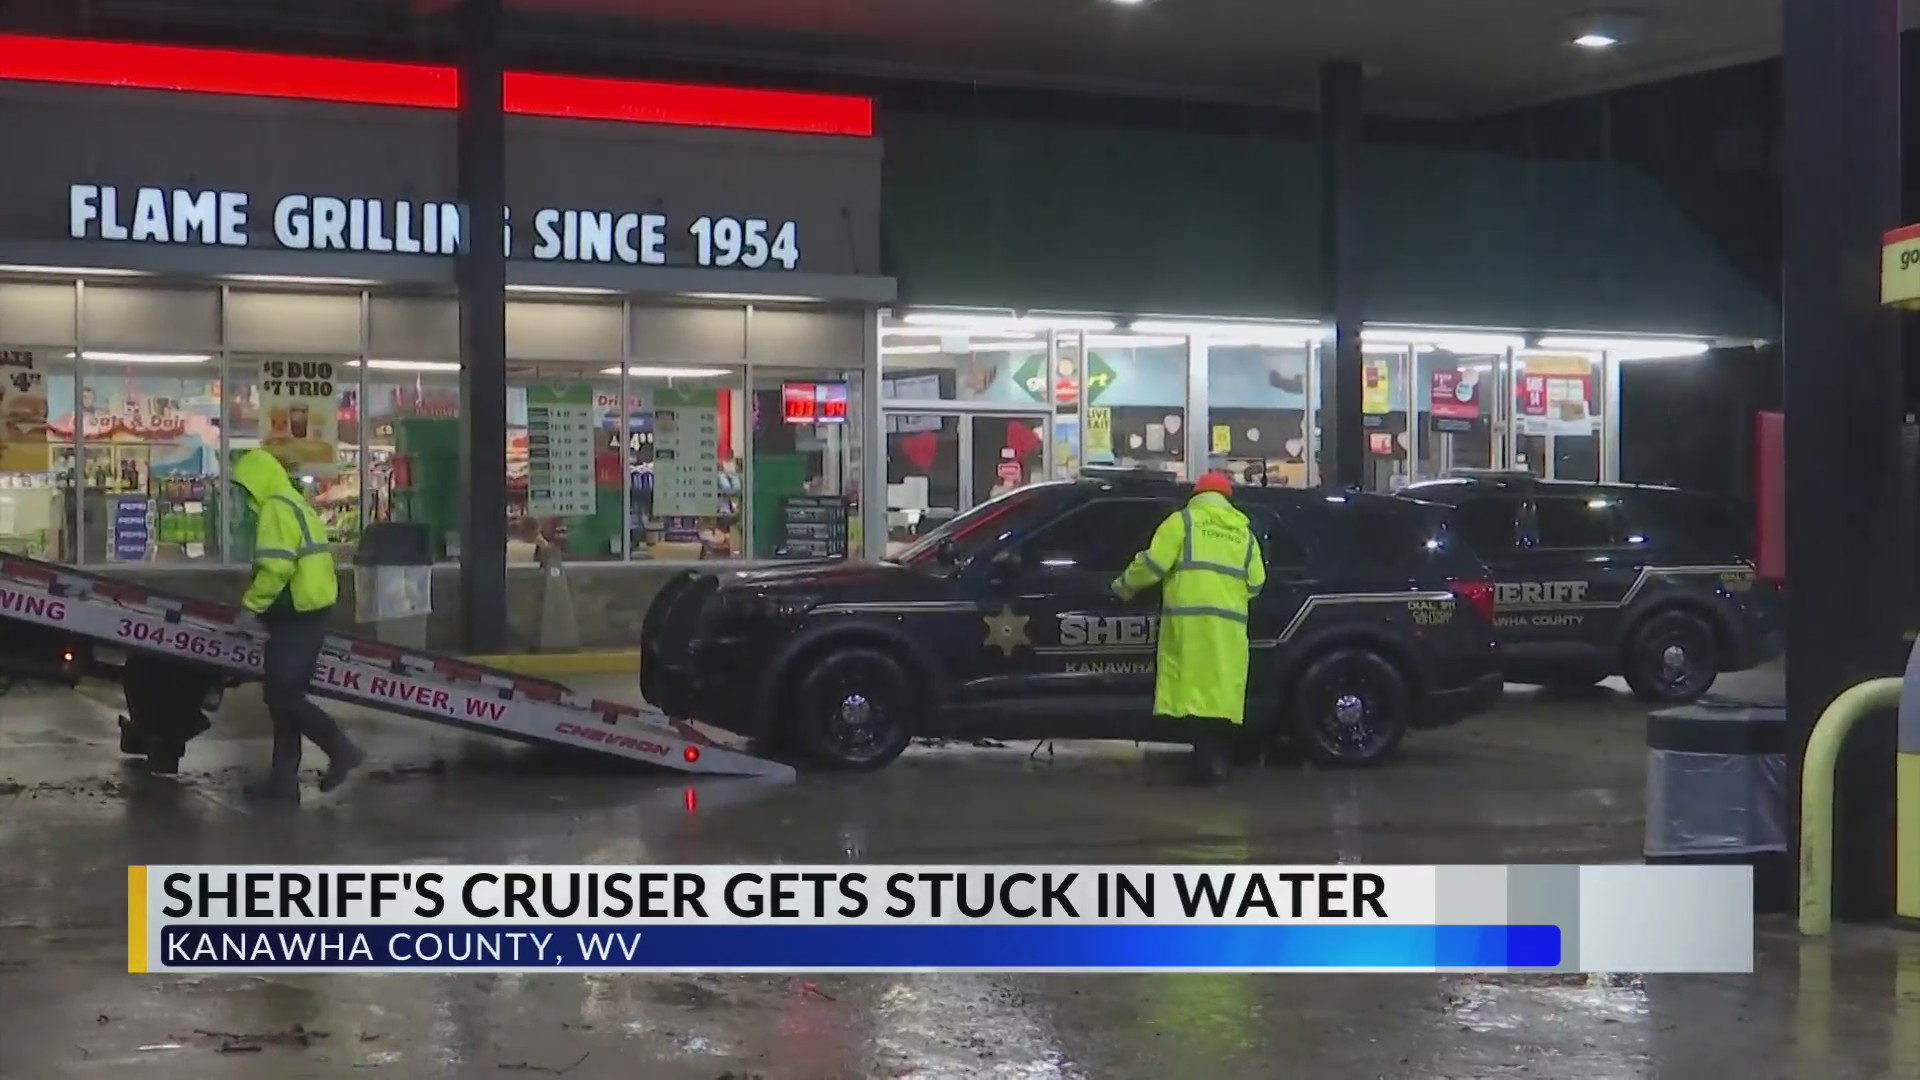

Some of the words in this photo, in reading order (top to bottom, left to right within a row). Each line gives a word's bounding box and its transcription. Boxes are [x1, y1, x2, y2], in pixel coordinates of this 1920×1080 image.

[71, 184, 248, 246] FLAME
[274, 194, 511, 258] GRILLIN
[534, 208, 666, 264] SINCE
[690, 216, 799, 270] 1954
[263, 361, 283, 379] $5
[287, 361, 333, 380] DUO
[263, 381, 283, 396] $7
[285, 381, 333, 397] TRIO
[1531, 615, 1584, 626] COUNTY
[117, 618, 261, 668] 304-965-56
[370, 676, 455, 715] RIVER,
[465, 697, 507, 721] WV
[554, 721, 671, 757] CHEVRON
